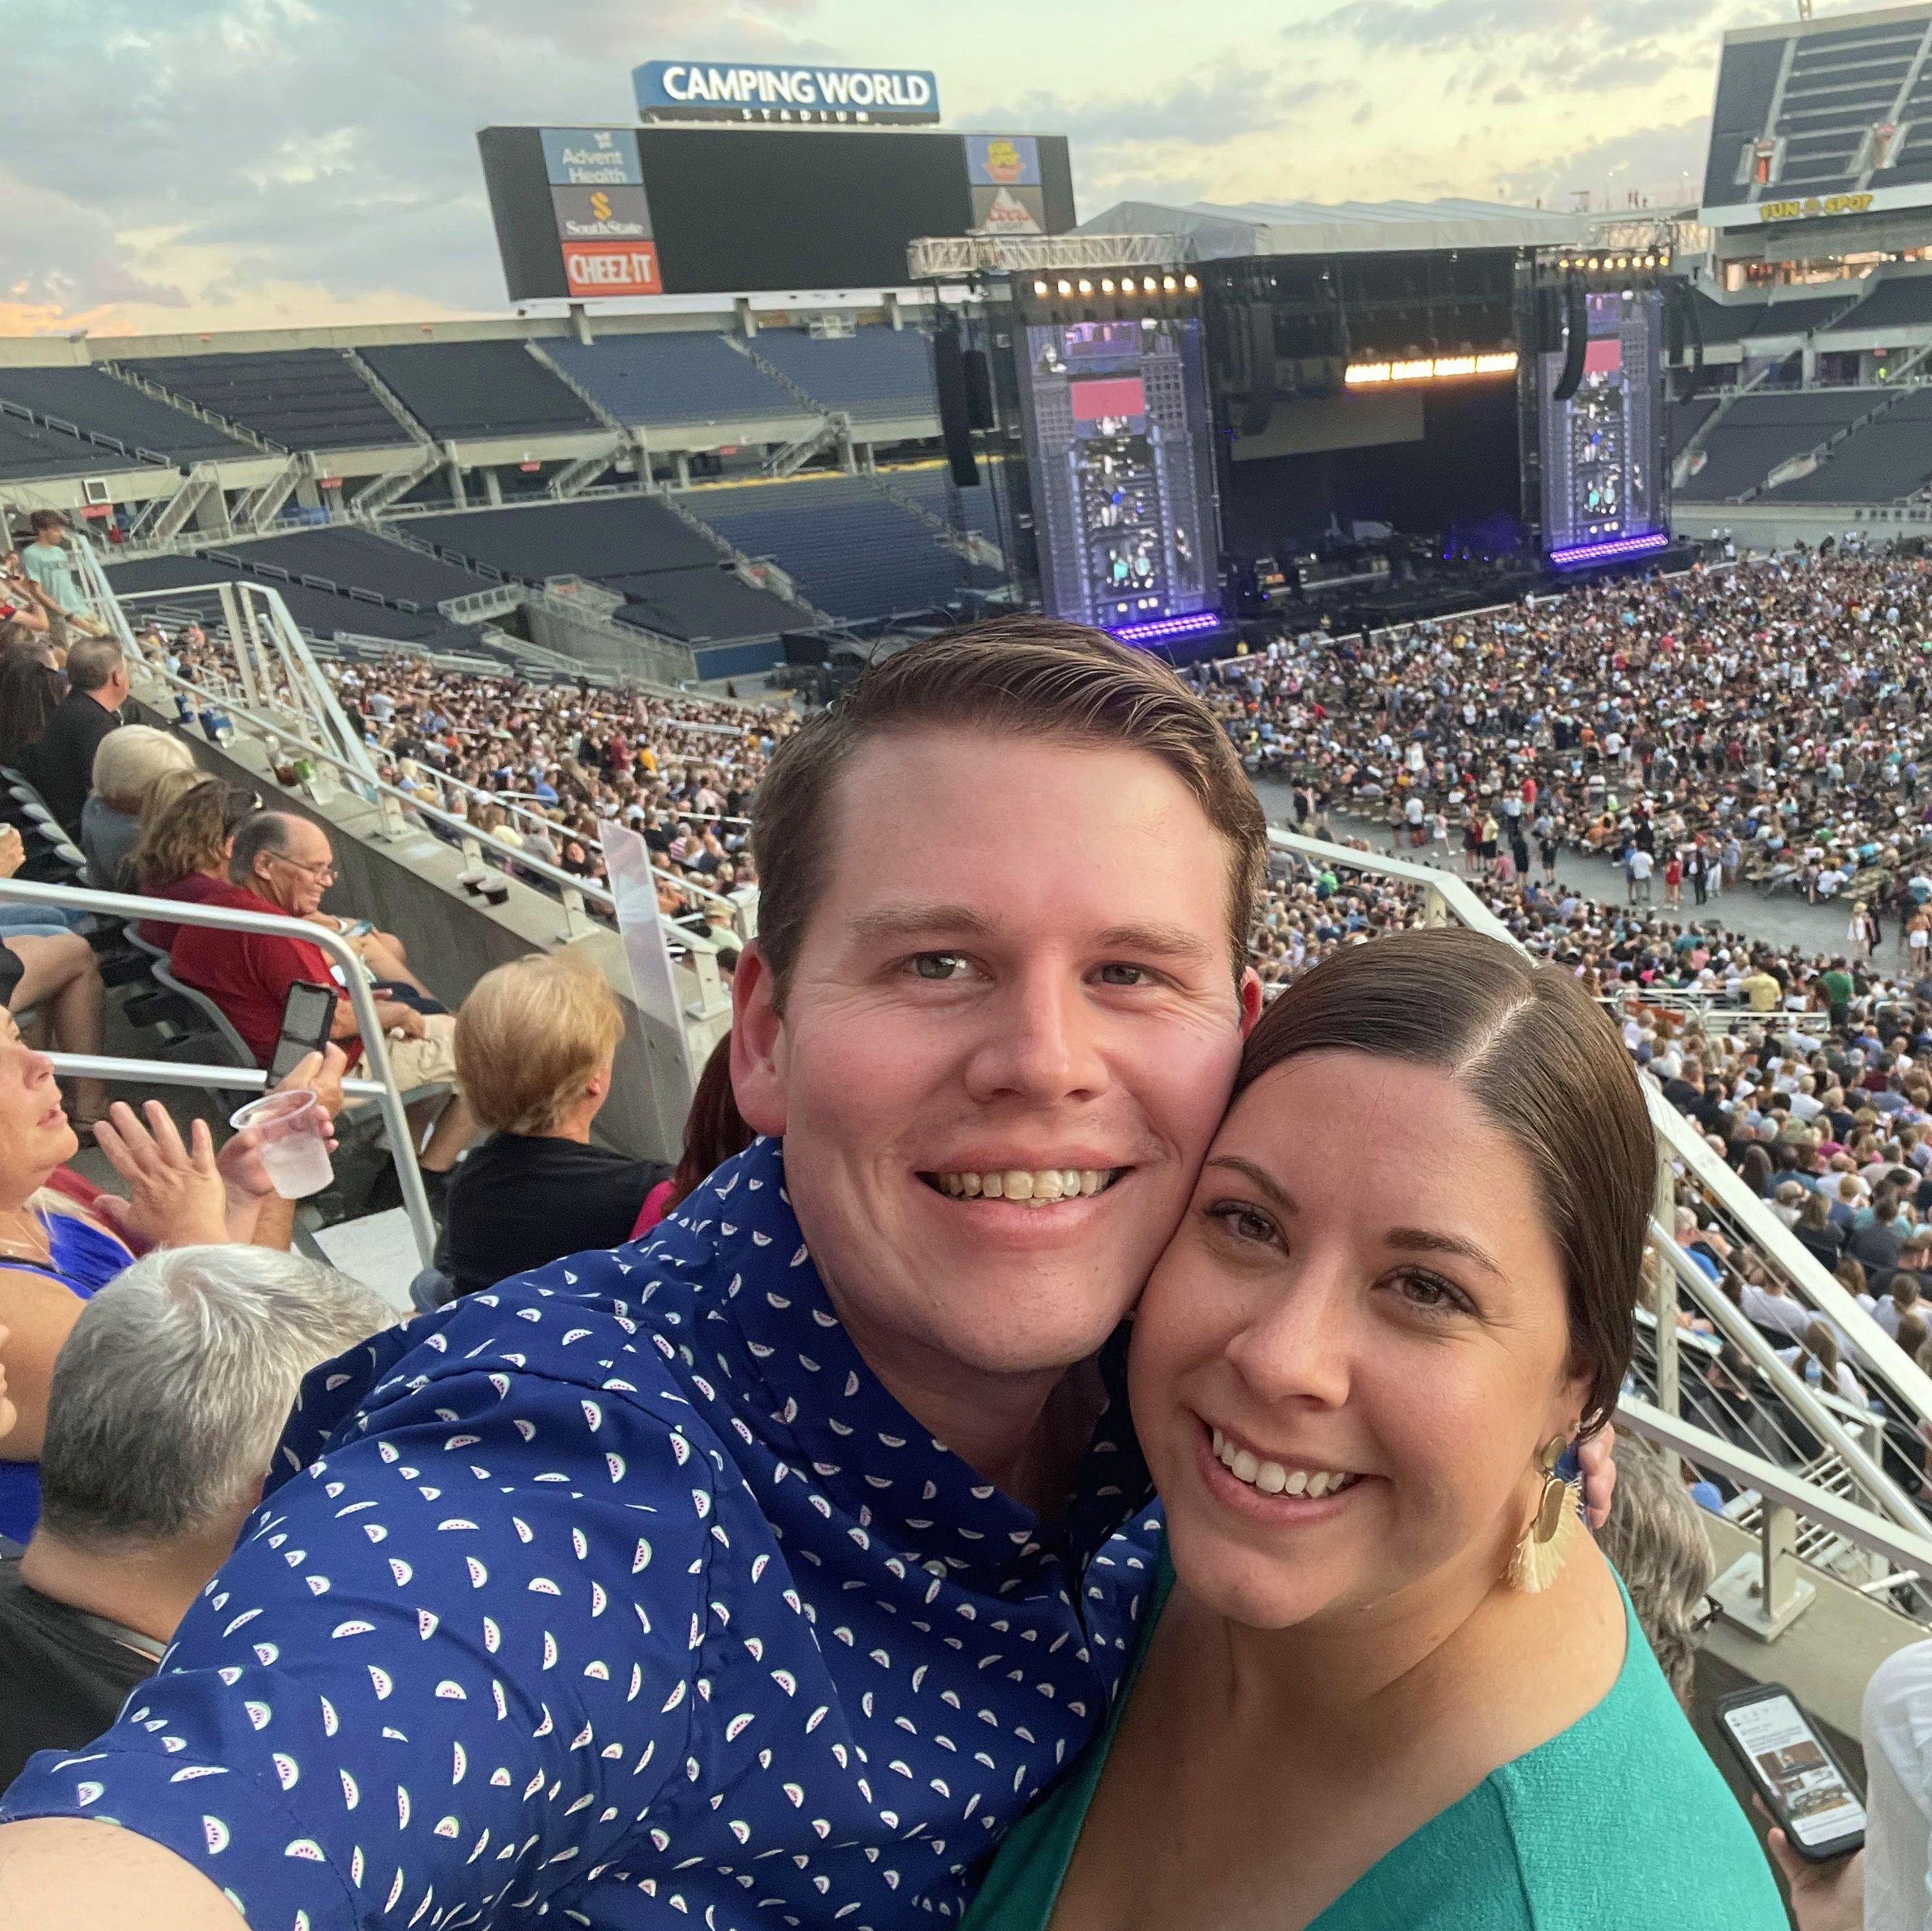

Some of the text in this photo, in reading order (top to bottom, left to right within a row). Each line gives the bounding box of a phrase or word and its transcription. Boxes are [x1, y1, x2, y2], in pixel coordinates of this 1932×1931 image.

[662, 66, 930, 105] CAMPING WORLD
[742, 108, 869, 122] STADIUM
[562, 148, 624, 165] Advent
[568, 167, 628, 184] Health
[1761, 194, 1873, 221] FUN SPOT
